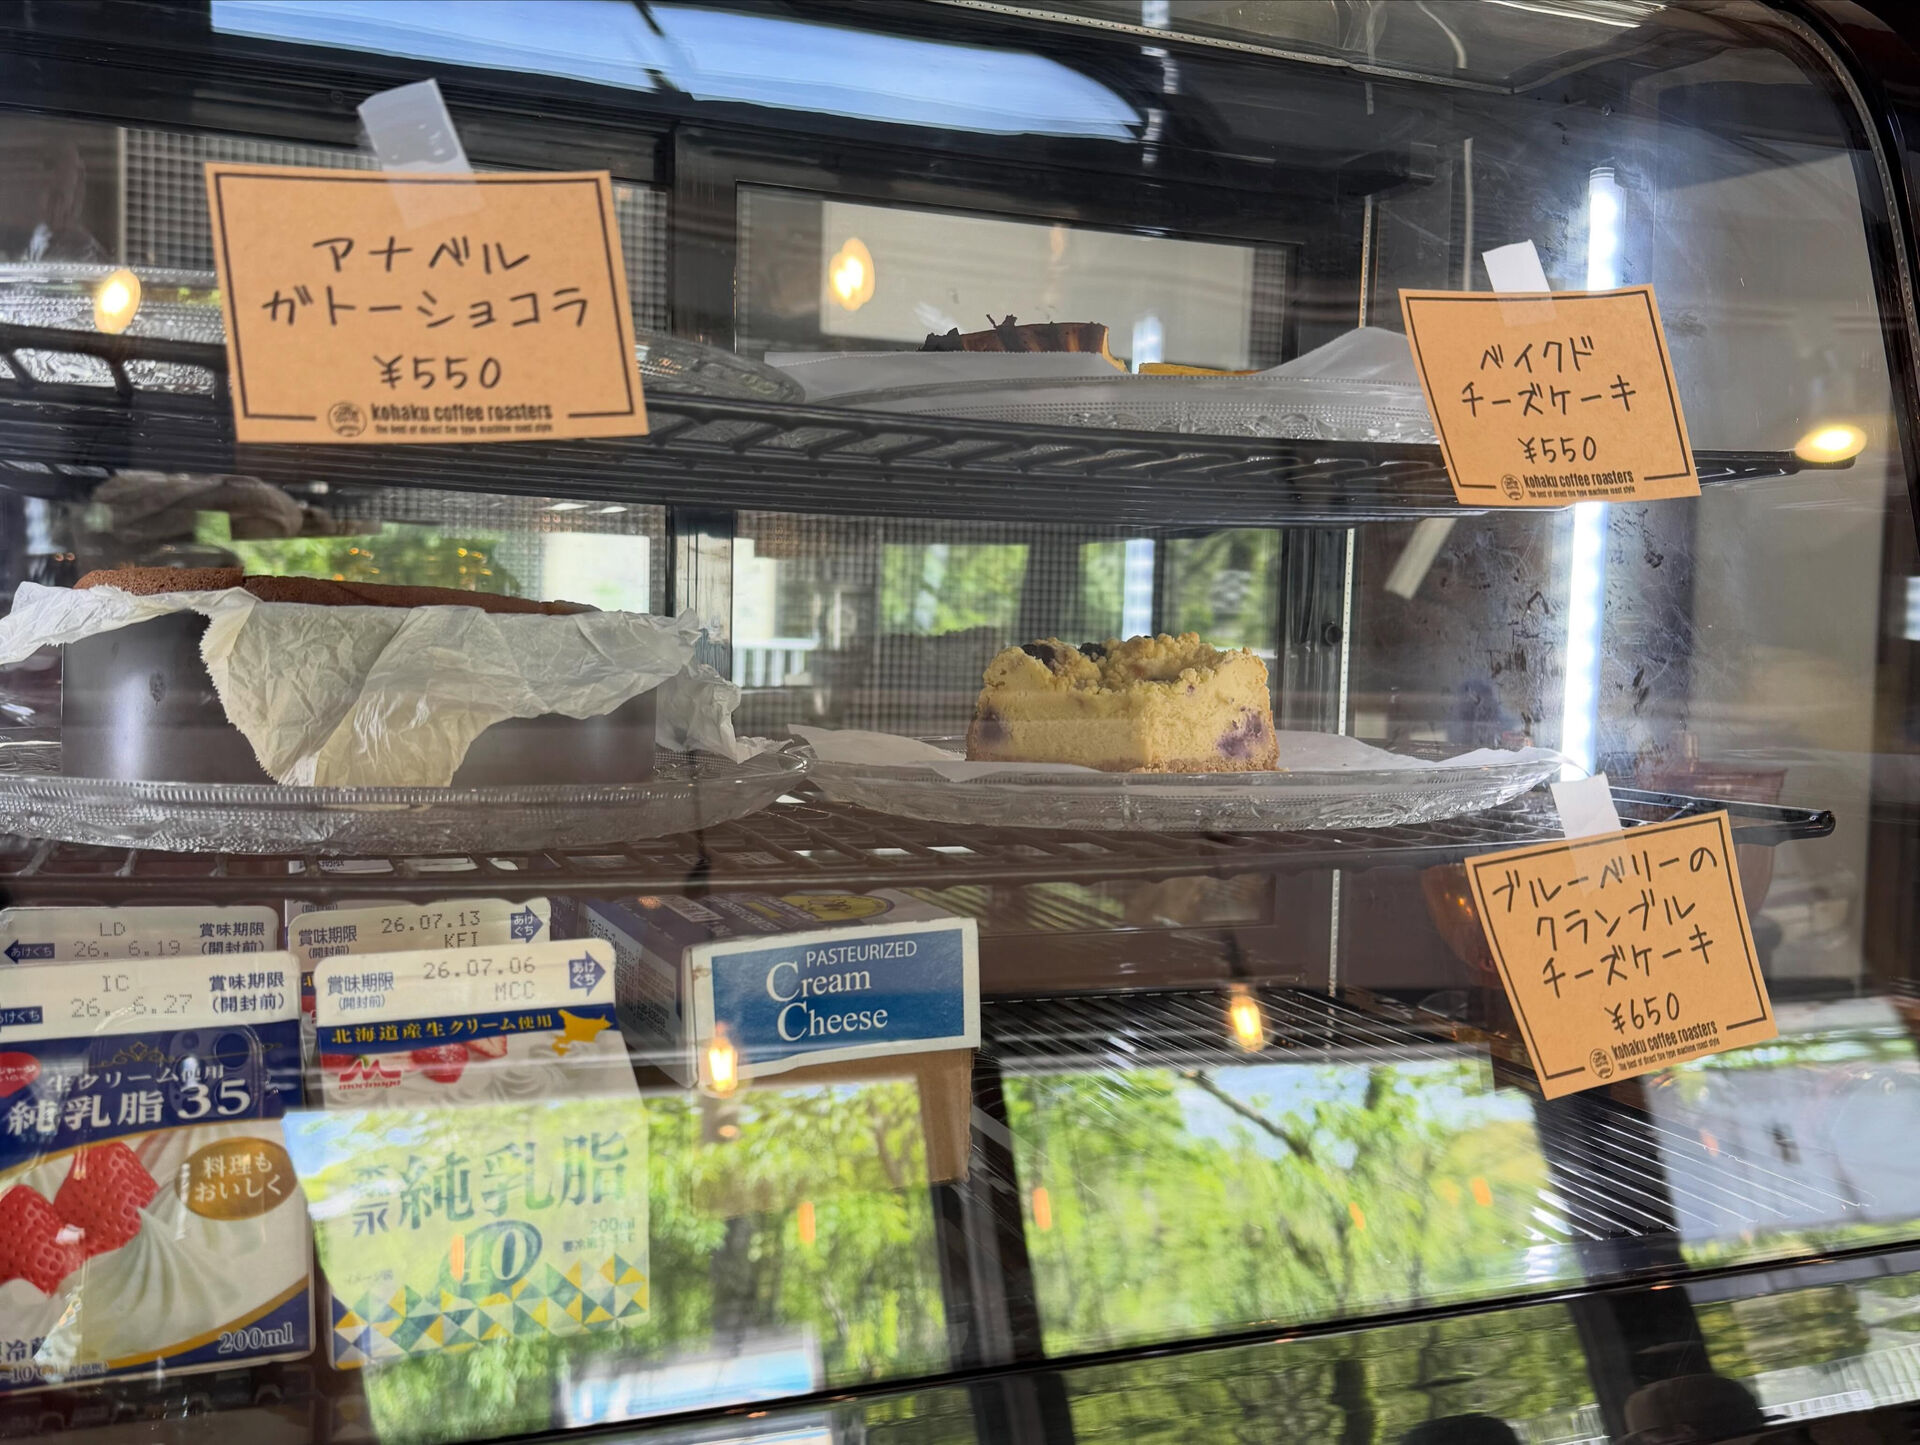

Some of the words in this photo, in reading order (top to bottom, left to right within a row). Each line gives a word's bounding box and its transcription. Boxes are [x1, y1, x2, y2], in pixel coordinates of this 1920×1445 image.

[313, 235, 530, 275] アナベル
[262, 284, 589, 328] ガトーショコラ
[1480, 335, 1594, 374] ベイクド
[373, 354, 502, 389] ¥550
[1461, 374, 1636, 418] チーズケーキ
[371, 403, 430, 421] kohaku
[434, 404, 484, 421] coffee
[487, 403, 553, 421] roasters
[1517, 436, 1597, 464] ¥550
[1522, 474, 1558, 488] kohaku
[1559, 473, 1591, 487] coffee
[1592, 470, 1634, 486] roasters
[1492, 846, 1717, 912] ブルーベリーの
[99, 921, 126, 937] LD
[199, 922, 265, 938] 賞味期限
[381, 910, 481, 935] 26.07.13
[513, 914, 534, 925] あけ
[1536, 888, 1696, 951] クランブル
[201, 940, 265, 955] (開封前)
[298, 925, 357, 946] 賞味期限
[443, 931, 478, 949] KFI
[309, 945, 350, 959] (開封前)
[806, 940, 918, 968] PASTEURIZED
[1542, 923, 1713, 999] チーズケーキ
[422, 956, 536, 981] 26.07.06
[572, 961, 596, 974] あけ
[102, 974, 130, 992] IC
[209, 971, 285, 993] 賞味期限
[327, 971, 394, 996] 賞味期限
[494, 980, 537, 1001] MCC
[766, 961, 872, 1003] Cream
[212, 992, 285, 1013] (開封前)
[339, 994, 386, 1010] (開封前)
[1604, 991, 1680, 1035] ¥650
[332, 1014, 553, 1045] 北海道産生クリーム使用
[777, 1001, 889, 1043] Cheese
[1611, 1039, 1648, 1060] kohaku
[1647, 1031, 1678, 1051] coffee
[1678, 1020, 1718, 1043] roasters
[7, 1090, 166, 1136] 純乳脂
[177, 1078, 251, 1120] 35
[203, 1151, 273, 1179] 料理も
[194, 1174, 282, 1203] おいしく
[399, 1131, 629, 1230] 純乳脂
[217, 1322, 294, 1354] 200ml
